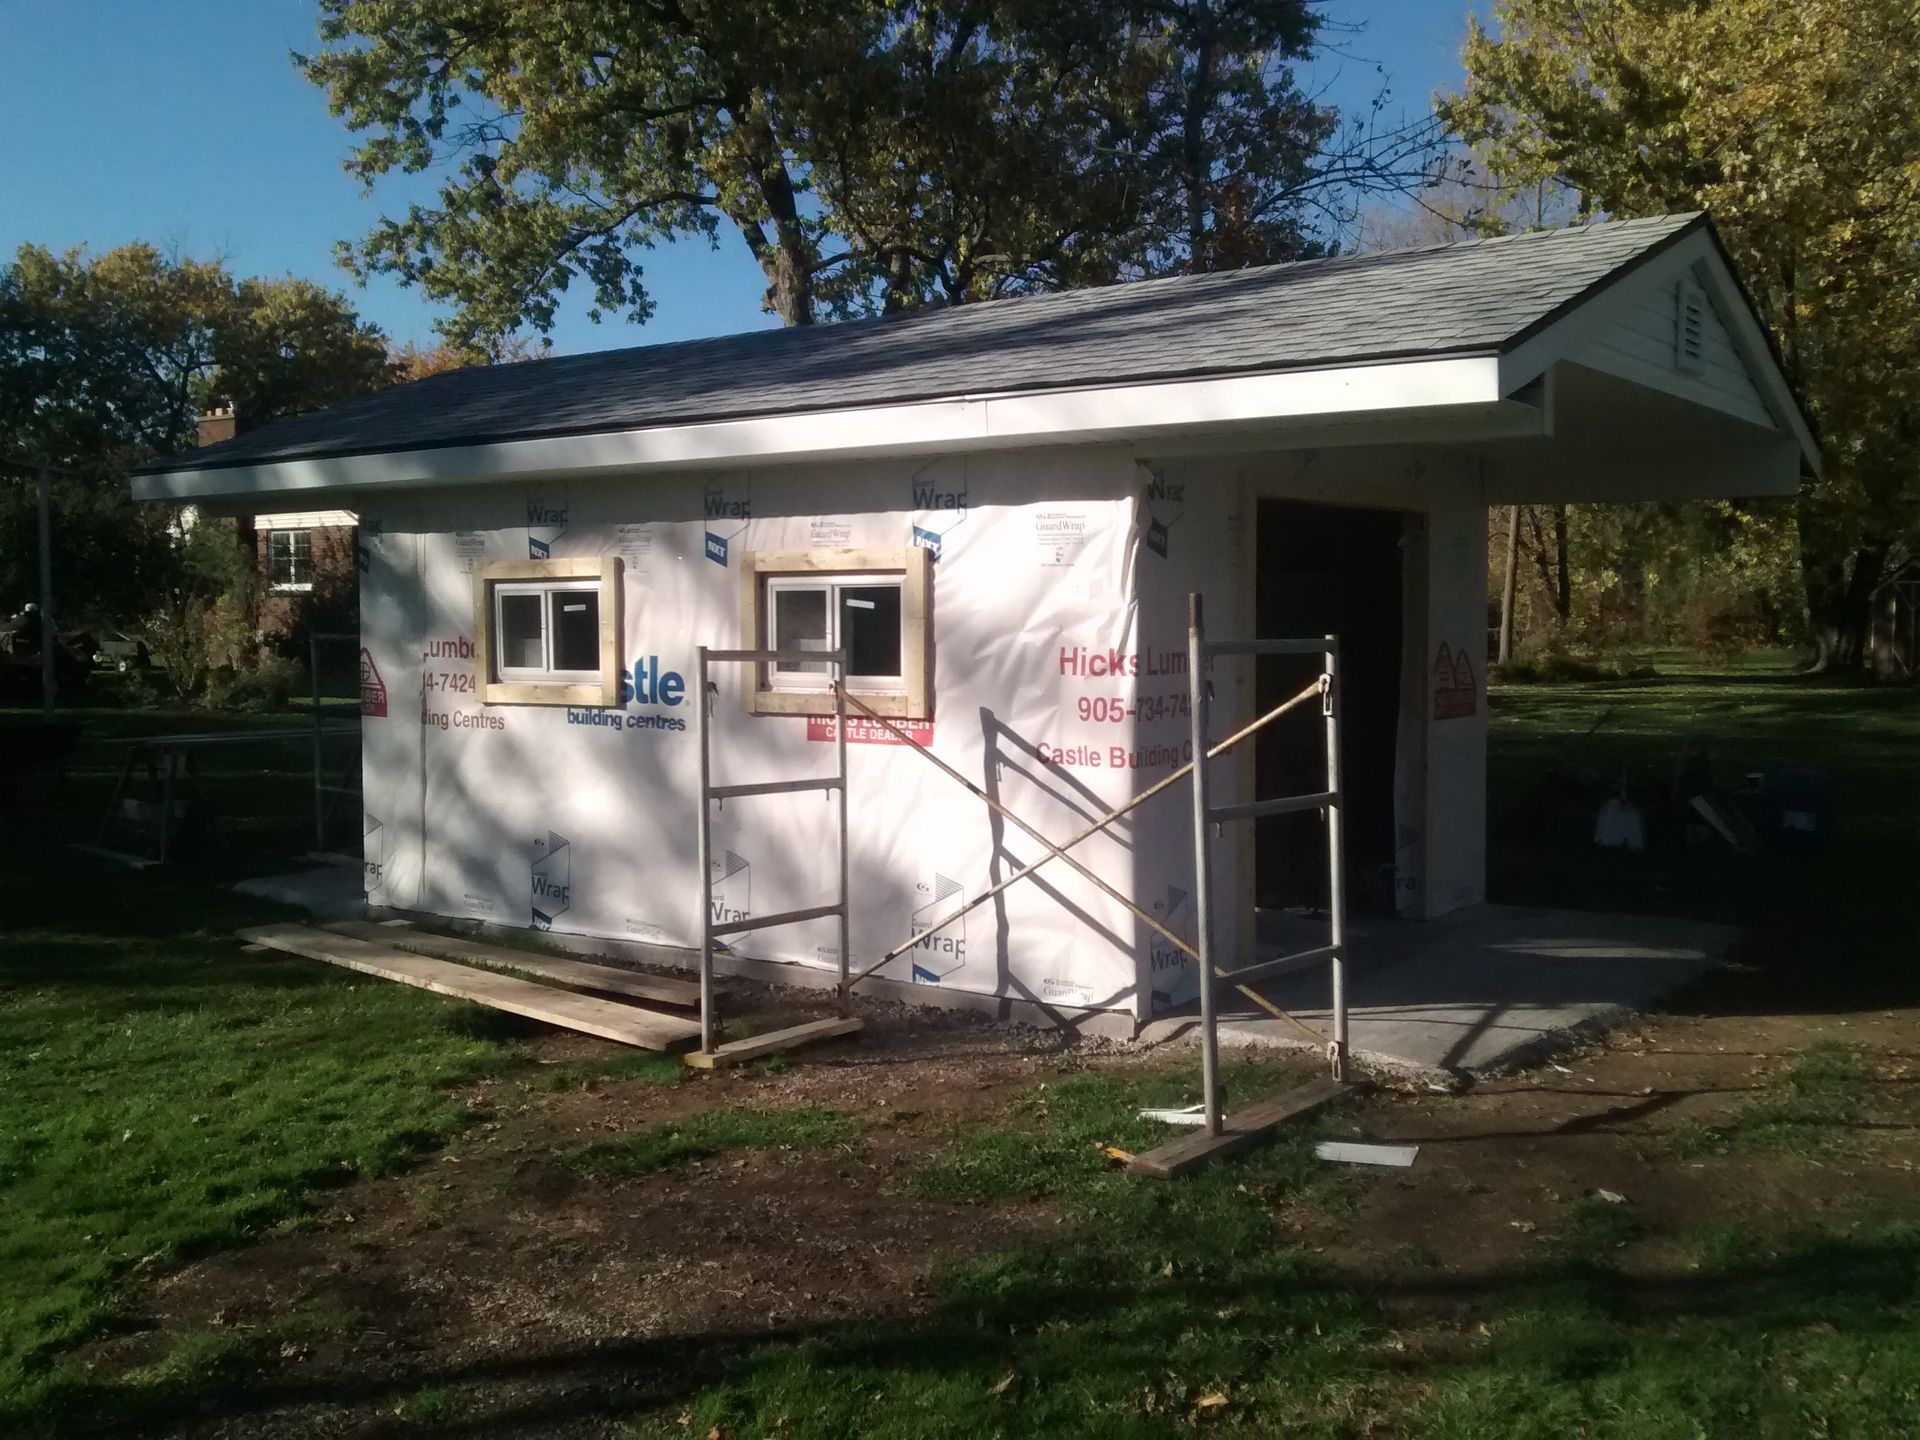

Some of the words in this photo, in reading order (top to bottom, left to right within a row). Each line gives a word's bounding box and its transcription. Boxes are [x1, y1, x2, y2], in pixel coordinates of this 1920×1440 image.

[704, 496, 751, 521] Wrap
[913, 488, 969, 514] Wrap
[527, 504, 568, 528] Wrap
[1035, 521, 1086, 532] GuardWrap
[708, 541, 726, 557] NXT
[424, 636, 475, 662] umb
[1060, 647, 1139, 677] Hicks
[423, 672, 476, 693] 4-7424
[567, 708, 623, 731] building
[626, 714, 686, 732] centres
[1078, 693, 1192, 723] 905-734-74
[454, 711, 505, 730] Centres
[1036, 742, 1102, 768] Castle
[1109, 744, 1178, 769] Building
[364, 860, 382, 879] rap
[532, 877, 570, 905] Wrap
